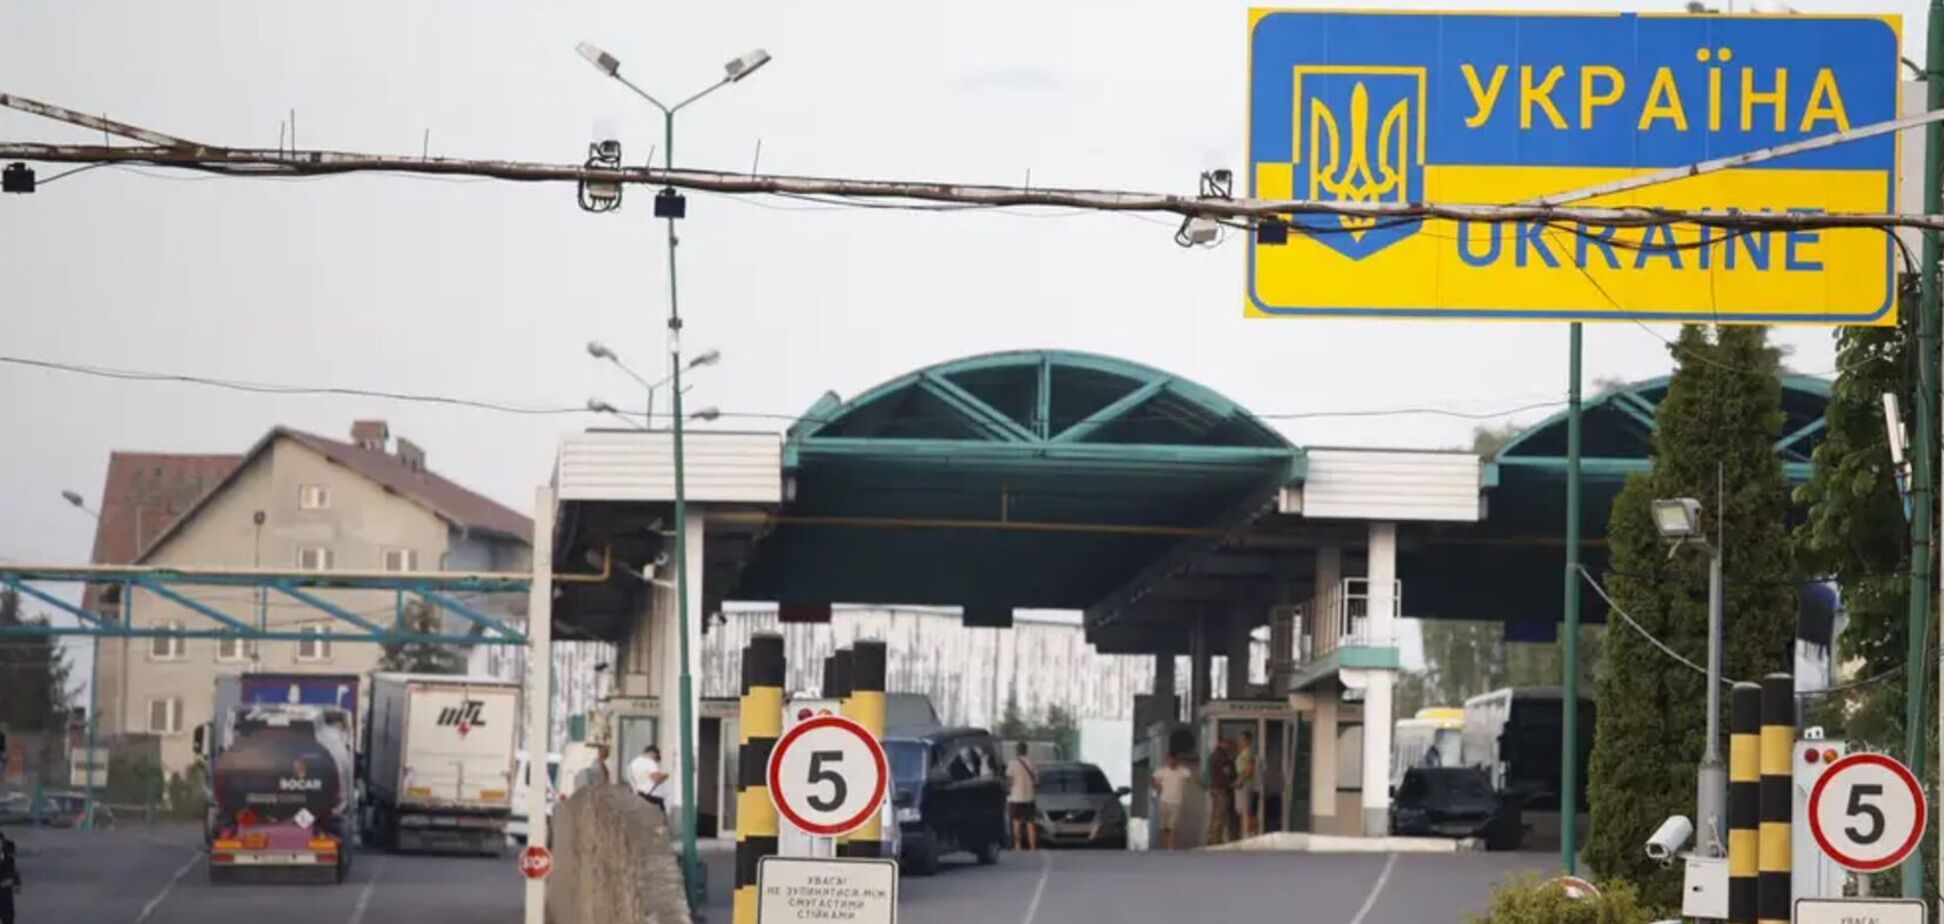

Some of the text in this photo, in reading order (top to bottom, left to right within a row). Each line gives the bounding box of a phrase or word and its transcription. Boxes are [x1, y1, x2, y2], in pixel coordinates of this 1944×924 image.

[1459, 46, 1852, 134] УКРАЇНА
[1456, 206, 1825, 272] UKRAINE
[279, 777, 322, 790] SOCAR
[806, 749, 848, 812] 5
[1844, 783, 1886, 845] 5
[807, 876, 847, 885] УВАГА!
[767, 886, 780, 895] НЕ
[786, 887, 859, 897] ЗУПИНЯТИСЯ
[788, 898, 865, 909] СМУГАСТИМИ
[797, 910, 855, 919] СТІЙКАМИ
